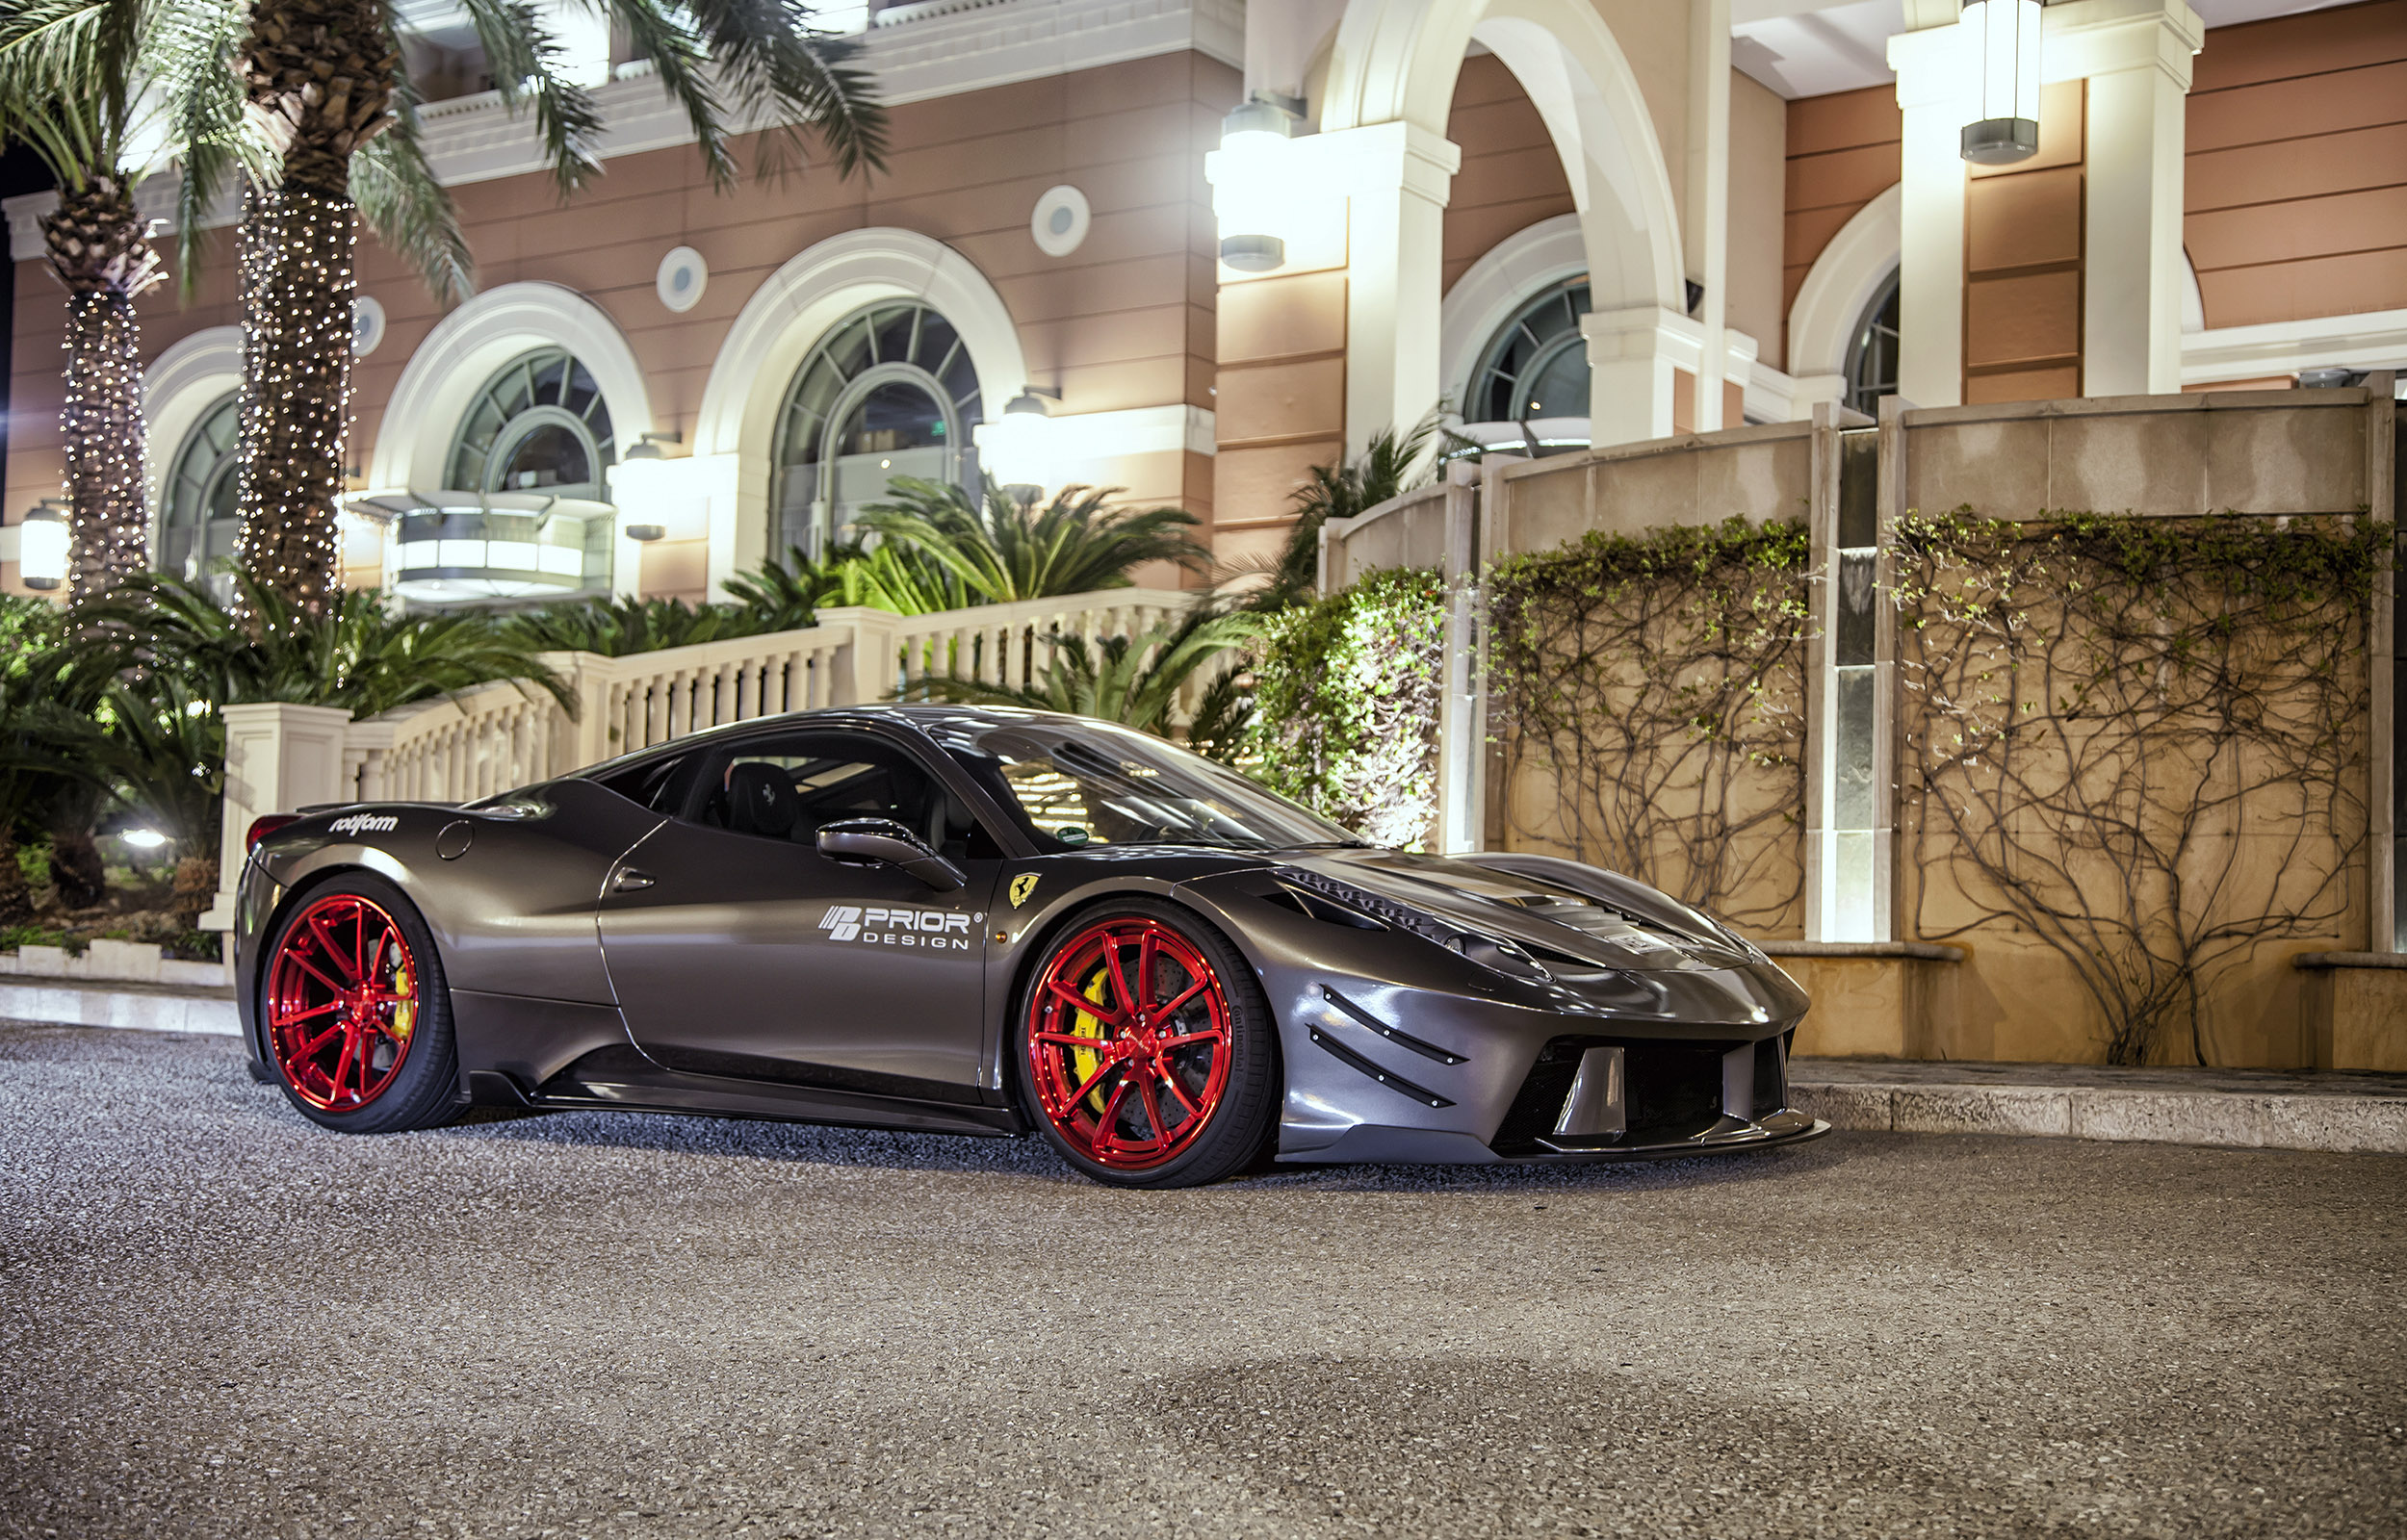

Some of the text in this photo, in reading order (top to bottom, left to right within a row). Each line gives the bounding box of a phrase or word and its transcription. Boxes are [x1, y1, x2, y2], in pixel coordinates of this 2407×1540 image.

[327, 812, 400, 836] rotiform
[863, 932, 969, 950] DESIGN
[1232, 1005, 1245, 1072] Continental
